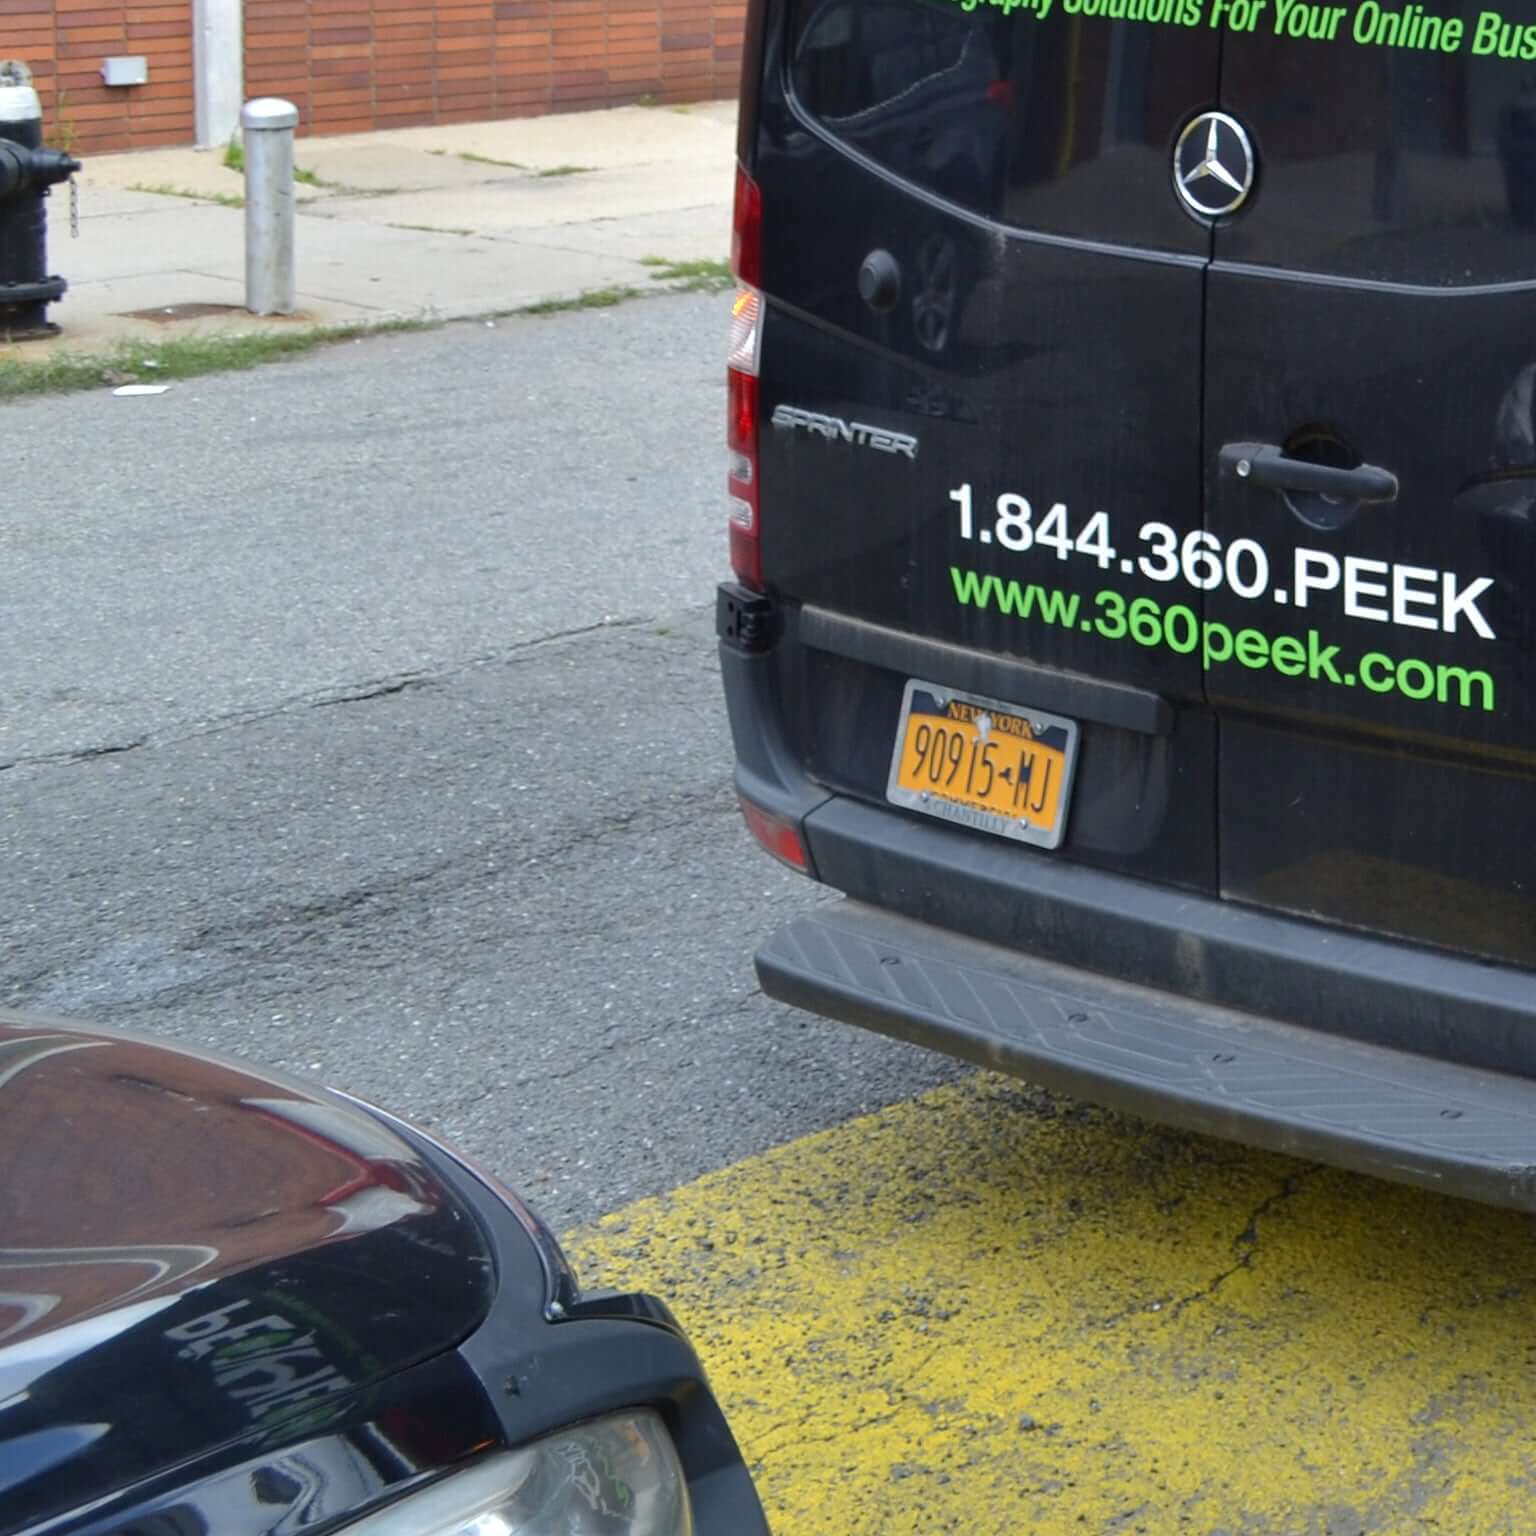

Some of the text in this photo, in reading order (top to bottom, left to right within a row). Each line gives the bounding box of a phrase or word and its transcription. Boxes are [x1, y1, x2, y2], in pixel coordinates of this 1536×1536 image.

[1352, 0, 1464, 52] Online
[771, 404, 917, 459] SPRINTER
[949, 483, 1497, 640] 1.844.360.PEEK
[950, 567, 1496, 711] www.360peek.com
[990, 711, 1034, 739] YORK
